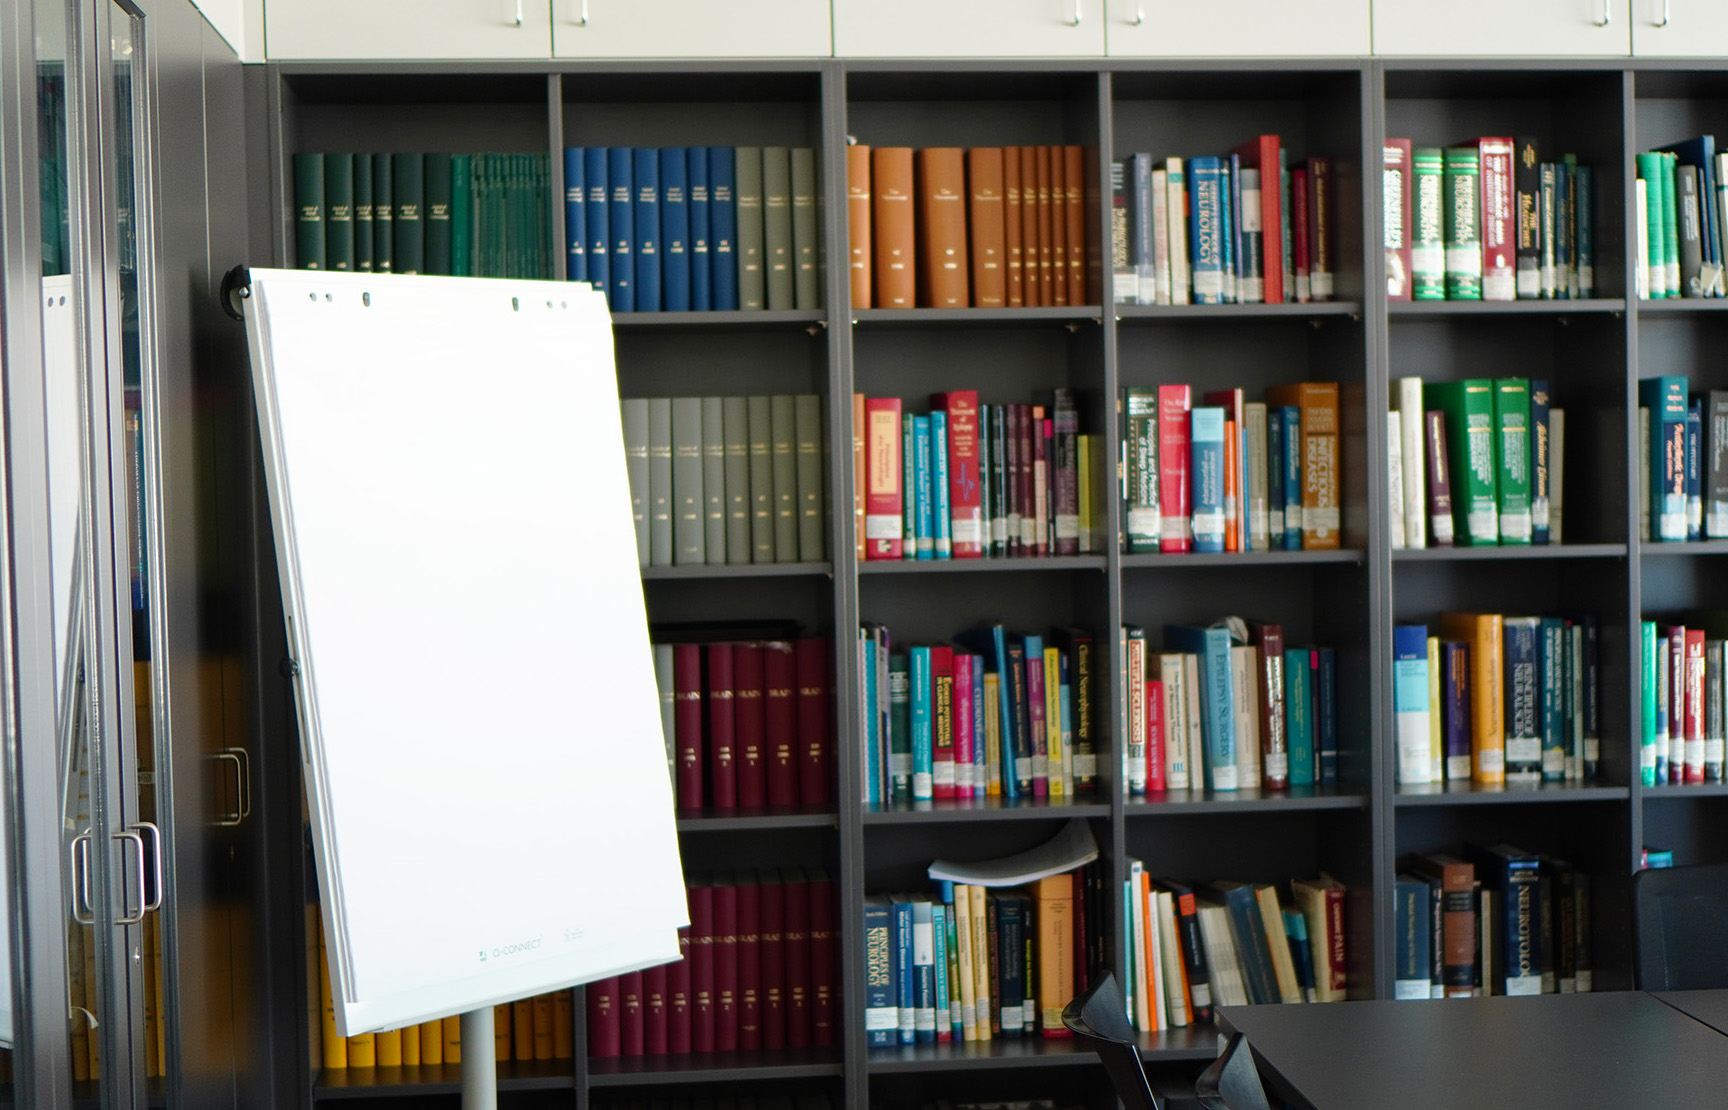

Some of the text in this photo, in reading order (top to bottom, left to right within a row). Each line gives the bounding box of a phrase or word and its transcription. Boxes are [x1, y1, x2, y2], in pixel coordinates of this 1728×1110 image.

[1198, 180, 1211, 264] NEUROLOGY
[1138, 437, 1148, 506] of Sleep Medicine
[1147, 419, 1157, 506] Principles and Practice
[1307, 437, 1318, 493] DISEASES
[1317, 437, 1329, 508] INFECTIOUS
[1078, 644, 1089, 738] Clinical Neurophysiology
[1131, 643, 1141, 743] MULTIPLE SCLEROSIS
[1514, 663, 1524, 710] NEURAL
[1524, 663, 1533, 735] PRINCIPLES OF
[1218, 706, 1230, 758] SURGERY
[1514, 709, 1524, 740] SCIEN
[492, 938, 542, 958] Q-CONNECT
[867, 927, 880, 987] NEUROLOGY
[879, 927, 890, 985] PRINCIPLES OF
[1334, 934, 1345, 962] PAIN
[1518, 885, 1530, 978] NEUROTOLOG
